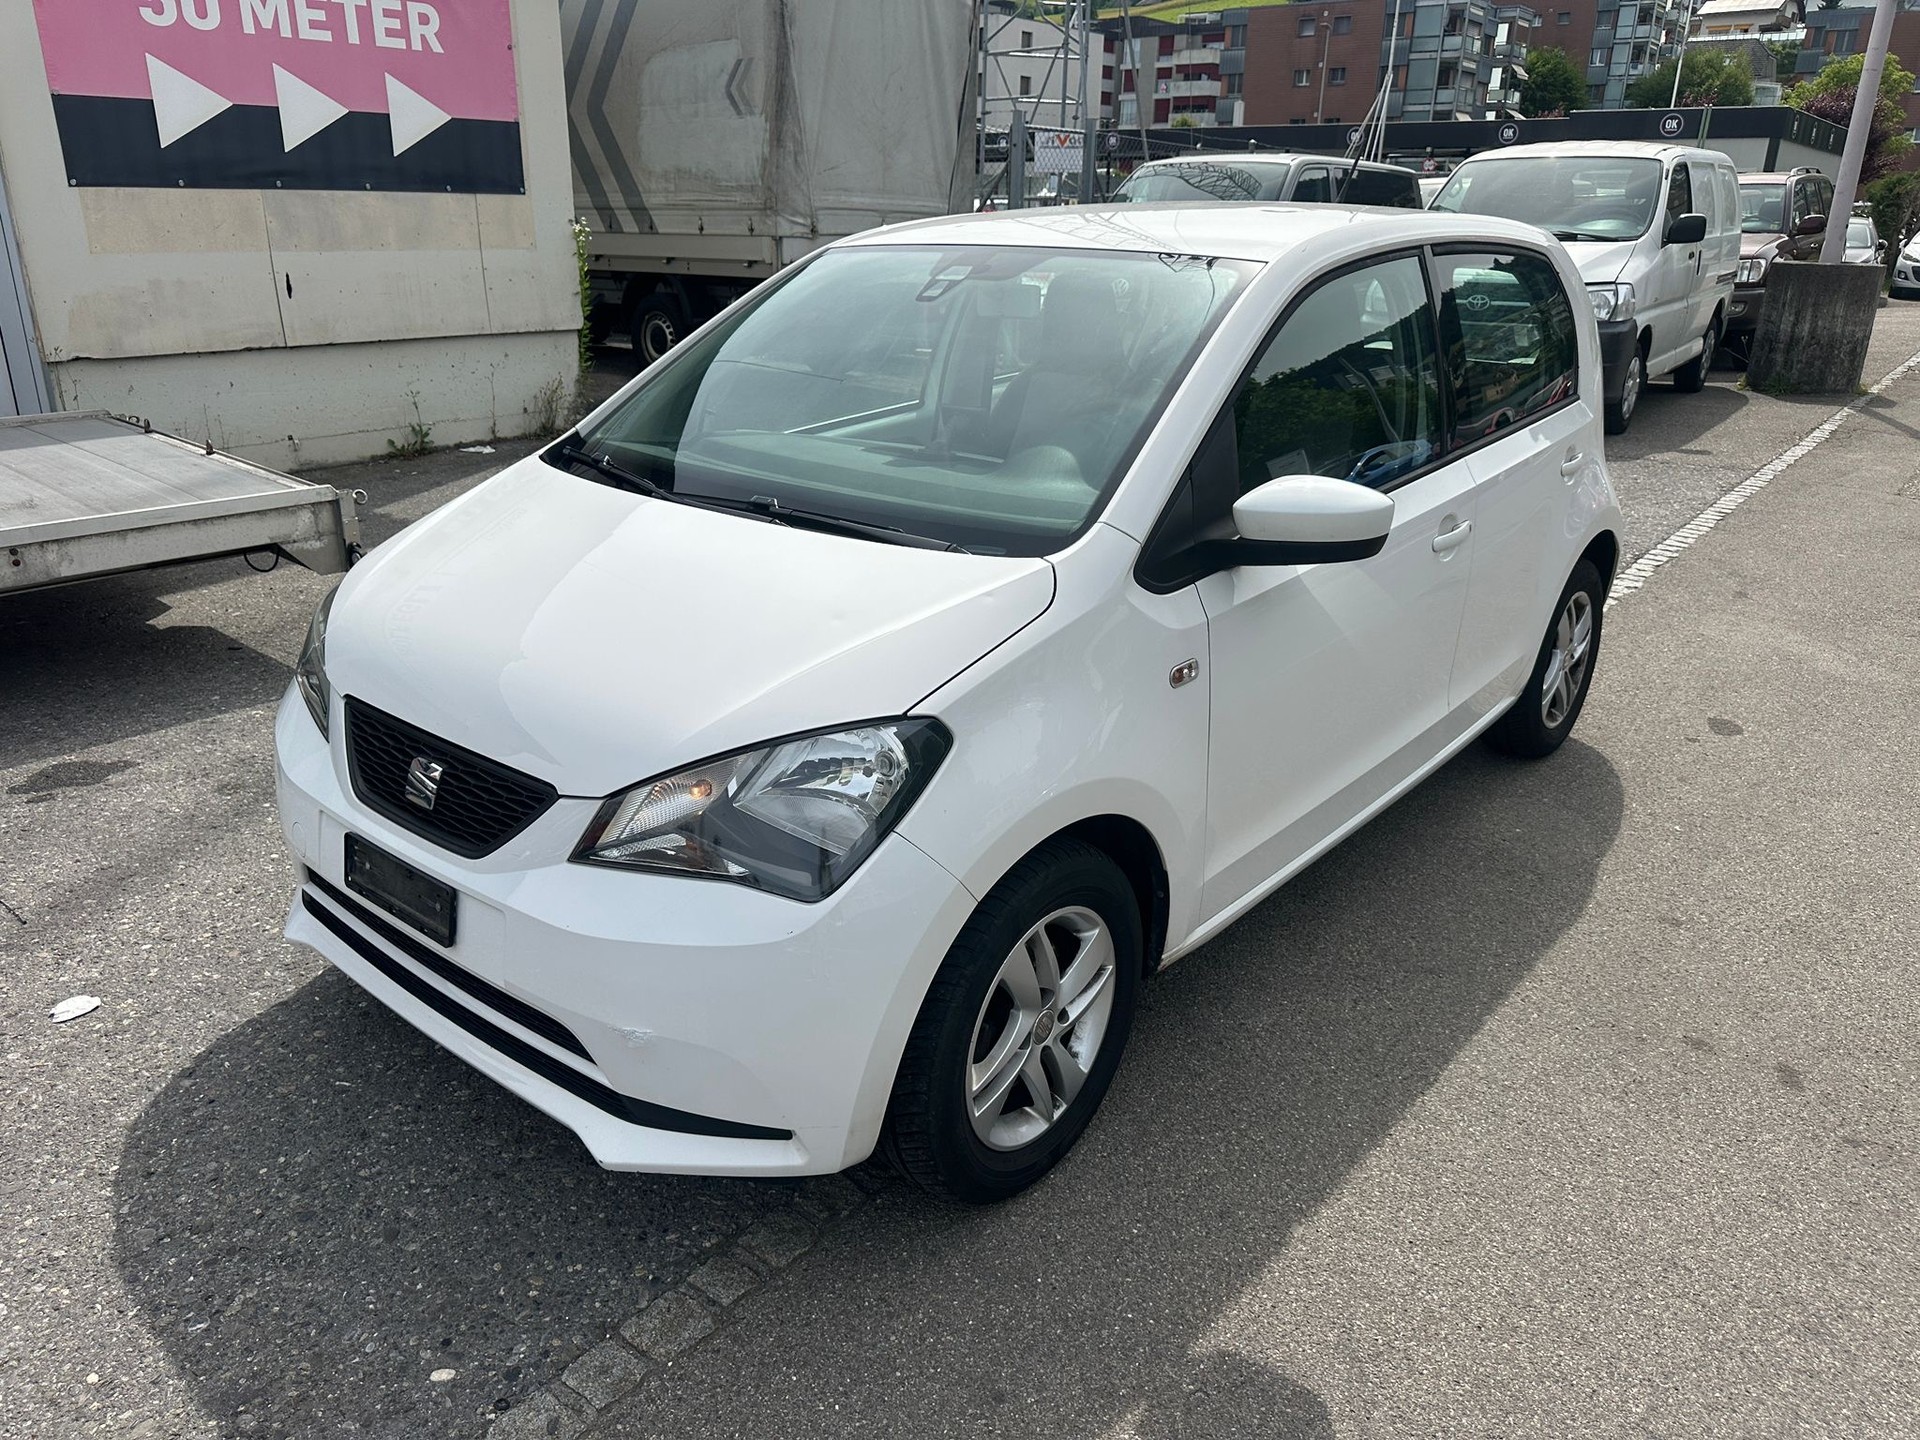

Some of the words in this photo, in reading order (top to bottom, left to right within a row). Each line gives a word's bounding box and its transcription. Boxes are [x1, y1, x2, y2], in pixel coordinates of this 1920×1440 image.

[239, 0, 445, 54] METER
[1665, 119, 1679, 129] OK
[1503, 128, 1515, 137] OK
